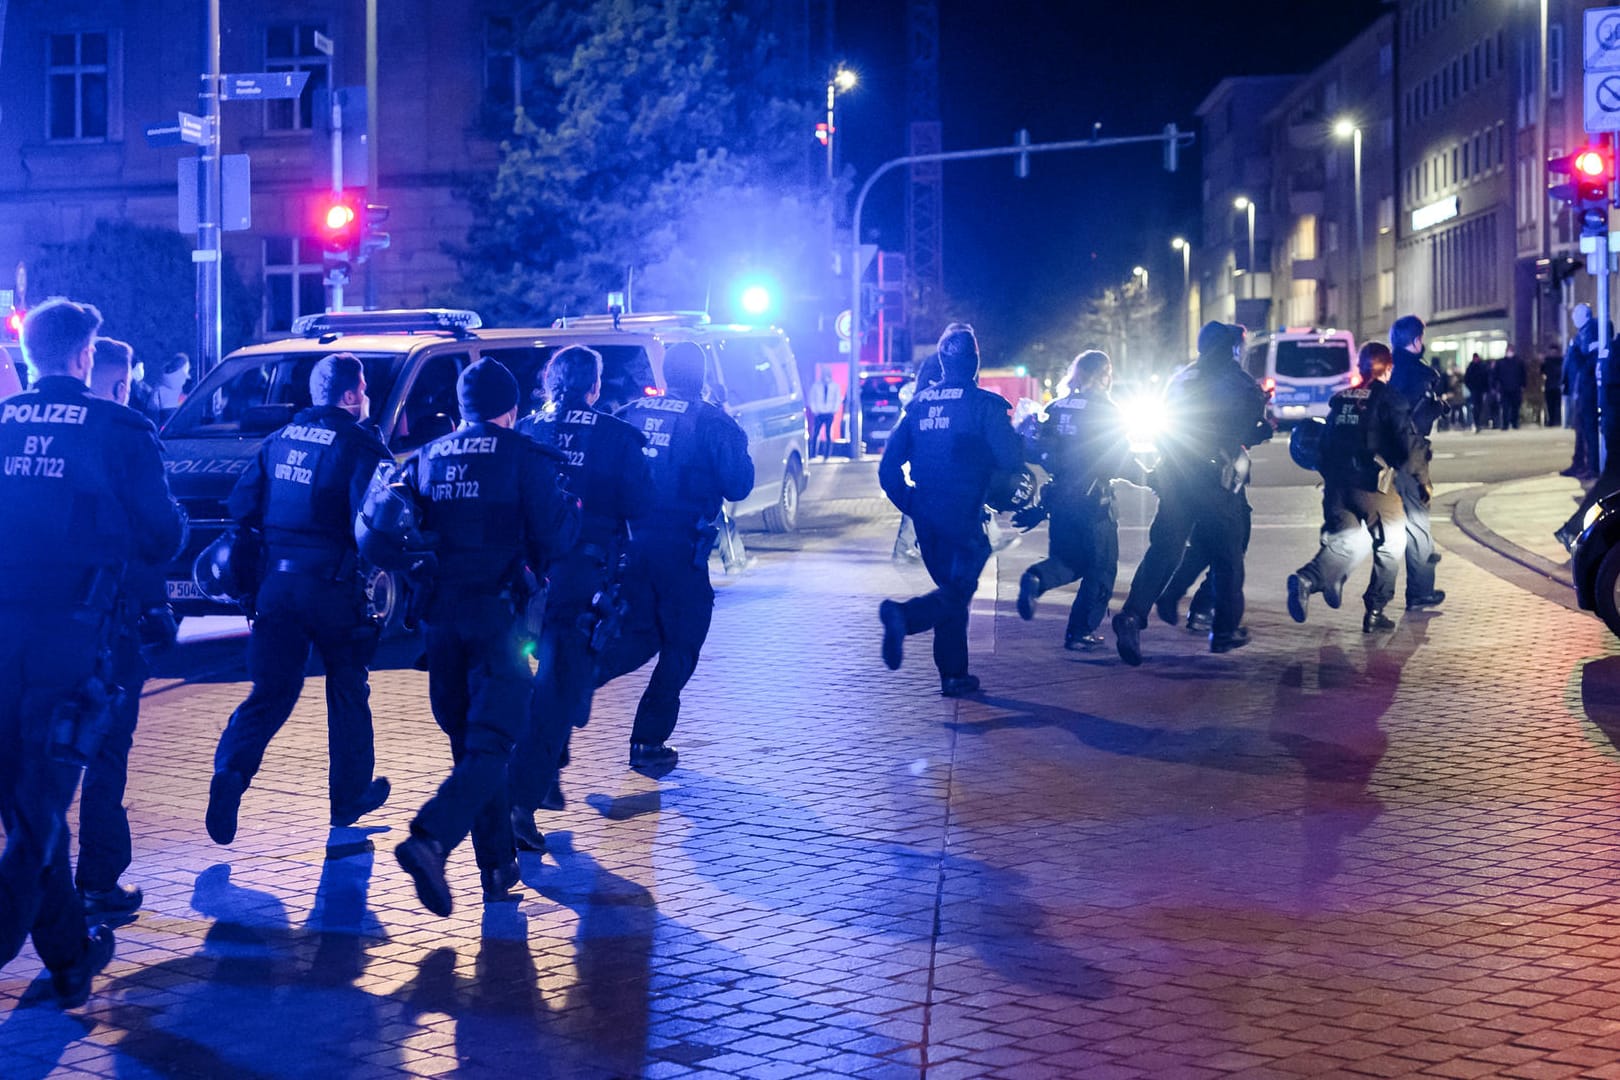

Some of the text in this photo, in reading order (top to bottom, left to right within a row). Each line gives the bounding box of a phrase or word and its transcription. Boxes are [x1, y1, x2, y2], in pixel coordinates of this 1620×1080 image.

[919, 388, 964, 402] POLIZEI
[635, 397, 690, 414] POLIZEI
[928, 405, 944, 418] BY
[0, 404, 88, 425] POLIZEI
[534, 410, 598, 426] POIZEI
[644, 418, 663, 432] BY
[280, 425, 336, 446] POLIZEI
[24, 436, 54, 455] BY
[428, 437, 498, 459] POLIZEI
[4, 456, 64, 478] UFR 7122
[163, 459, 254, 475] POLIZEI
[286, 450, 308, 467] BY
[446, 464, 468, 481] BY
[432, 481, 480, 502] UFR 7122
